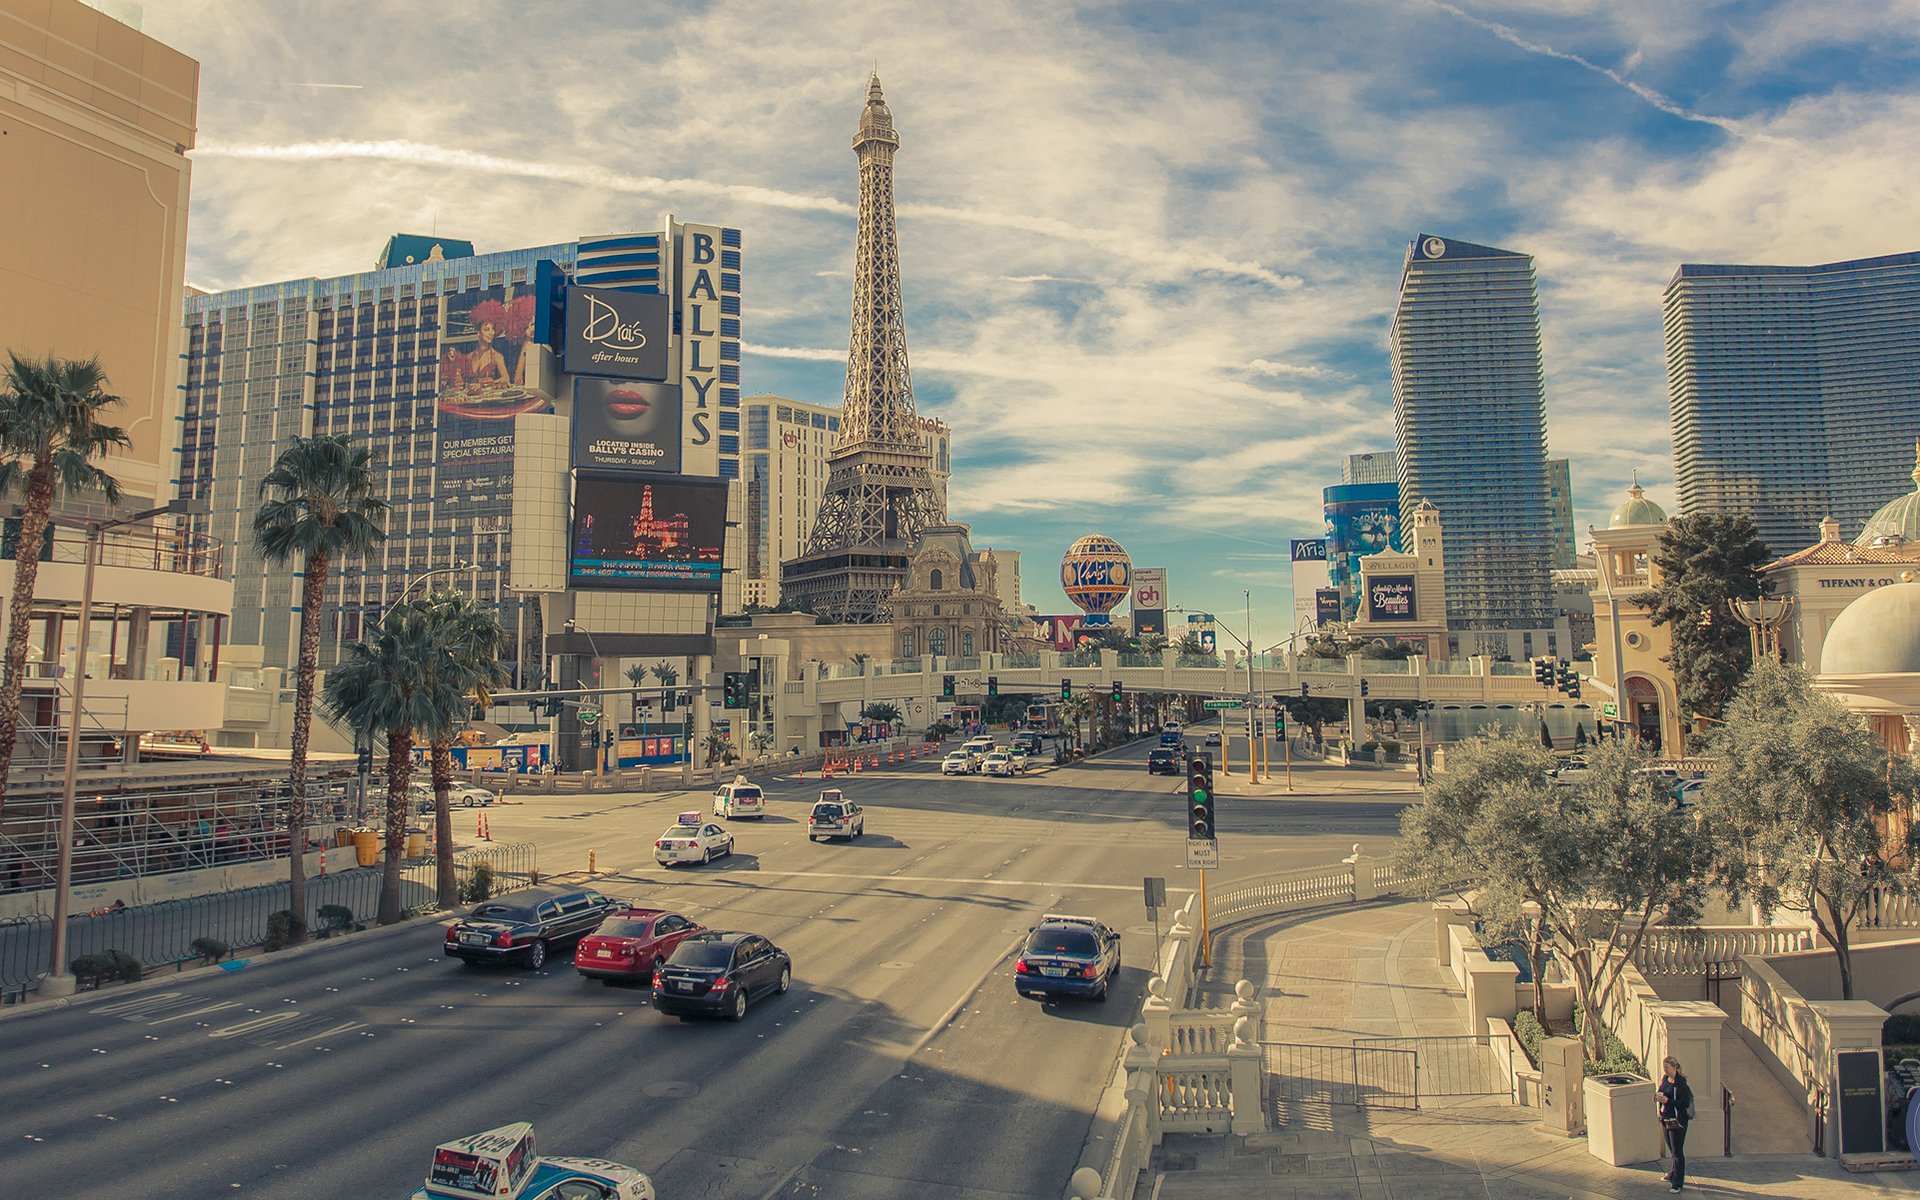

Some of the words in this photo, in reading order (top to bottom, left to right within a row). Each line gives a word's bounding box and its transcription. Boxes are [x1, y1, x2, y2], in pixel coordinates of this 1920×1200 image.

[583, 294, 647, 350] Drai's
[687, 233, 718, 445] BALLYS
[591, 351, 613, 363] after
[614, 353, 638, 364] hours
[918, 416, 944, 434] net
[443, 441, 459, 449] OUR
[460, 437, 496, 448] MEMBERS
[497, 435, 513, 444] GET
[596, 440, 629, 448] LOCATED
[443, 449, 471, 459] SPECIAL
[473, 445, 515, 456] RESTAURAN
[589, 445, 627, 455] BALLY'S
[629, 448, 664, 457] CASINO
[595, 456, 627, 464] THURSDAY
[632, 458, 656, 466] SUNDAY
[1295, 542, 1326, 558] Aria
[1366, 561, 1416, 570] BELLAGIO
[1079, 559, 1106, 590] Paris
[1819, 579, 1866, 588] TIFFANY
[1193, 849, 1210, 857] MUST
